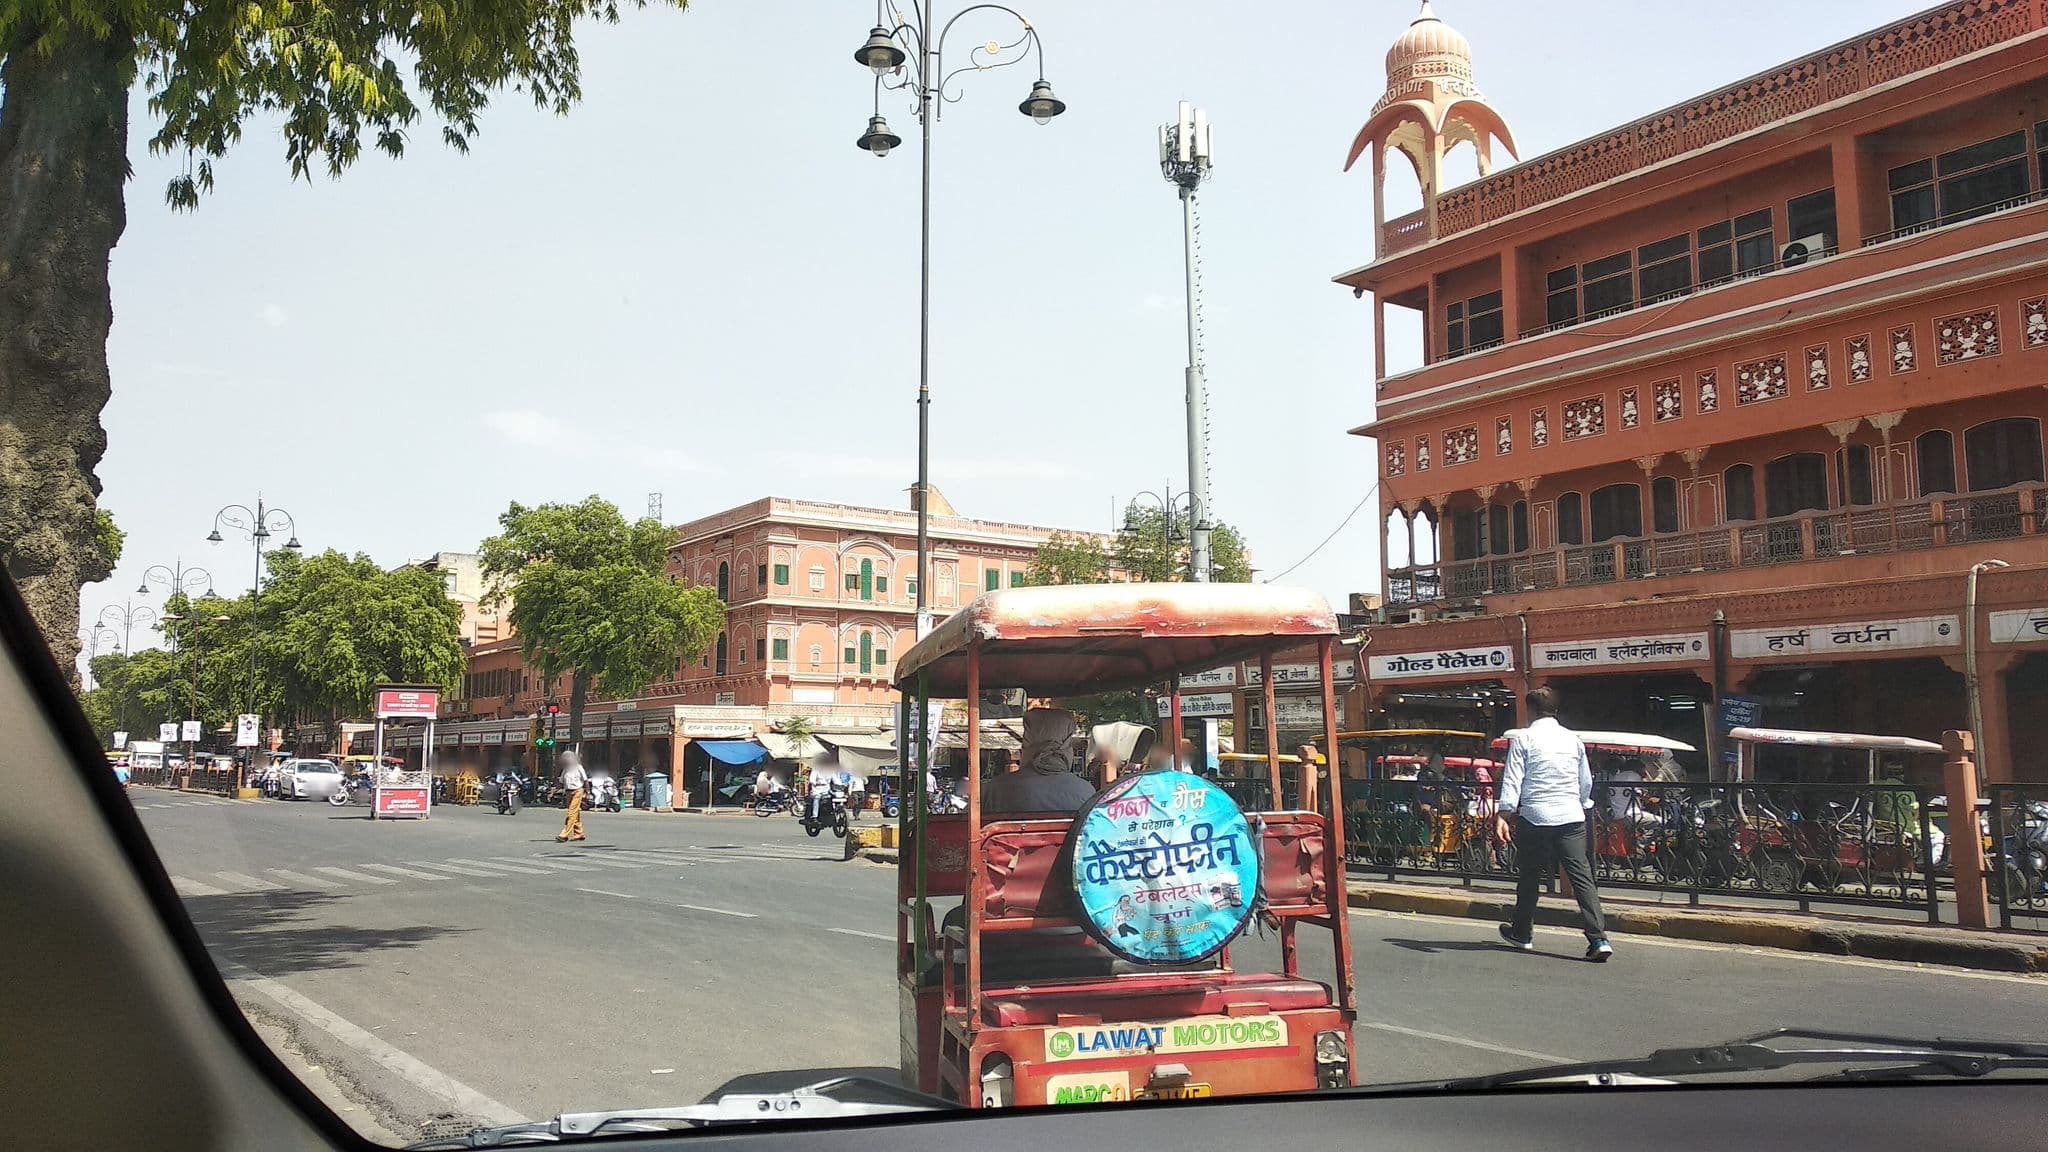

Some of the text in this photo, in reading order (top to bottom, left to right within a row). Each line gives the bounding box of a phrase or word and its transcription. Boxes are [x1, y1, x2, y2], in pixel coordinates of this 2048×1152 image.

[1766, 624, 1898, 652] हर्ष वर्धन
[1387, 656, 1434, 672] गोल्ड
[1437, 652, 1488, 669] पैलेस
[1546, 647, 1597, 662] काचवाला
[1107, 794, 1154, 820] कब्ज
[1172, 781, 1210, 810] गैस
[1128, 821, 1138, 833] से
[1141, 818, 1175, 831] परेशान
[1083, 822, 1241, 886] कैस्टोफीन
[1133, 882, 1202, 903] टेबलेट्स
[1149, 906, 1193, 924] चूर्ण
[1077, 1026, 1166, 1053] LAWAT
[1173, 1020, 1281, 1047] MOTORS
